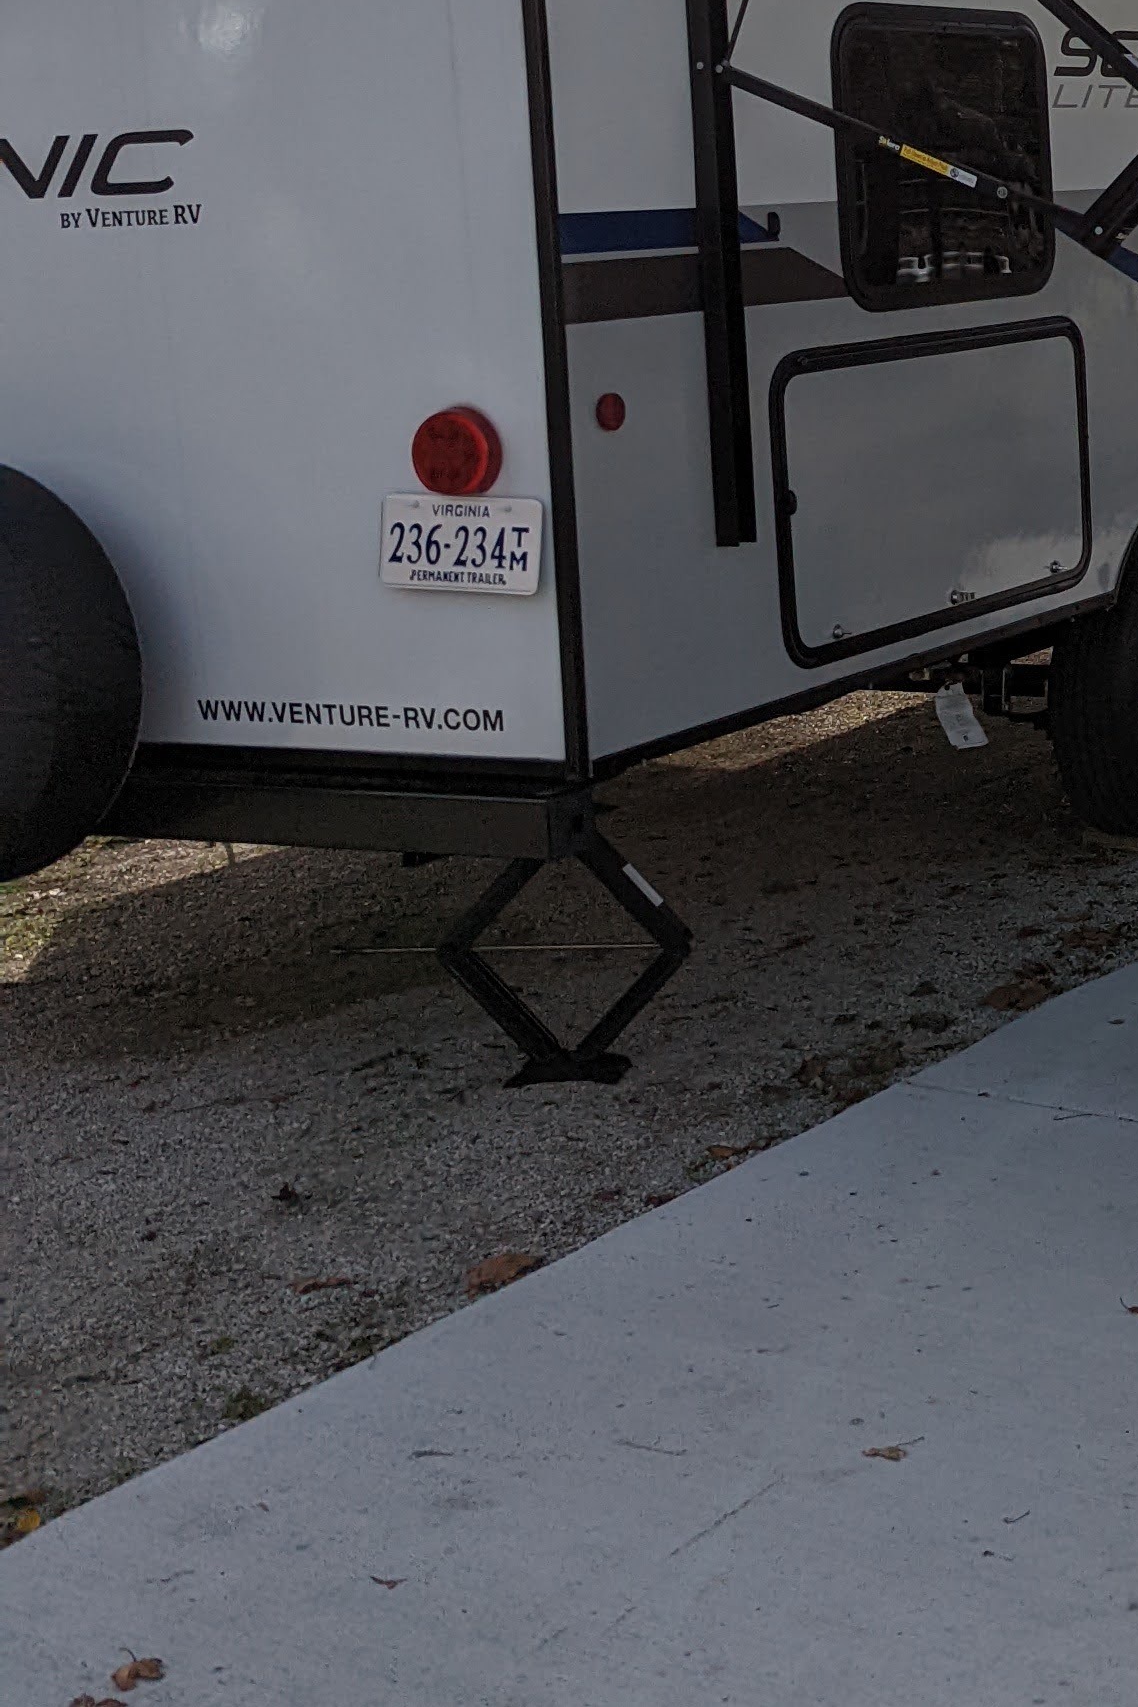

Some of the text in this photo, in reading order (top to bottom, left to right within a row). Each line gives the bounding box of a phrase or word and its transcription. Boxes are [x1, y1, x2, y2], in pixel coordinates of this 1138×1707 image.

[60, 203, 202, 229] BY VENTURE RV
[432, 504, 491, 518] VIRGINIA
[410, 569, 506, 585] PERMANENT TRAILER
[197, 699, 505, 732] WWW.VENTURE-RV.COM
